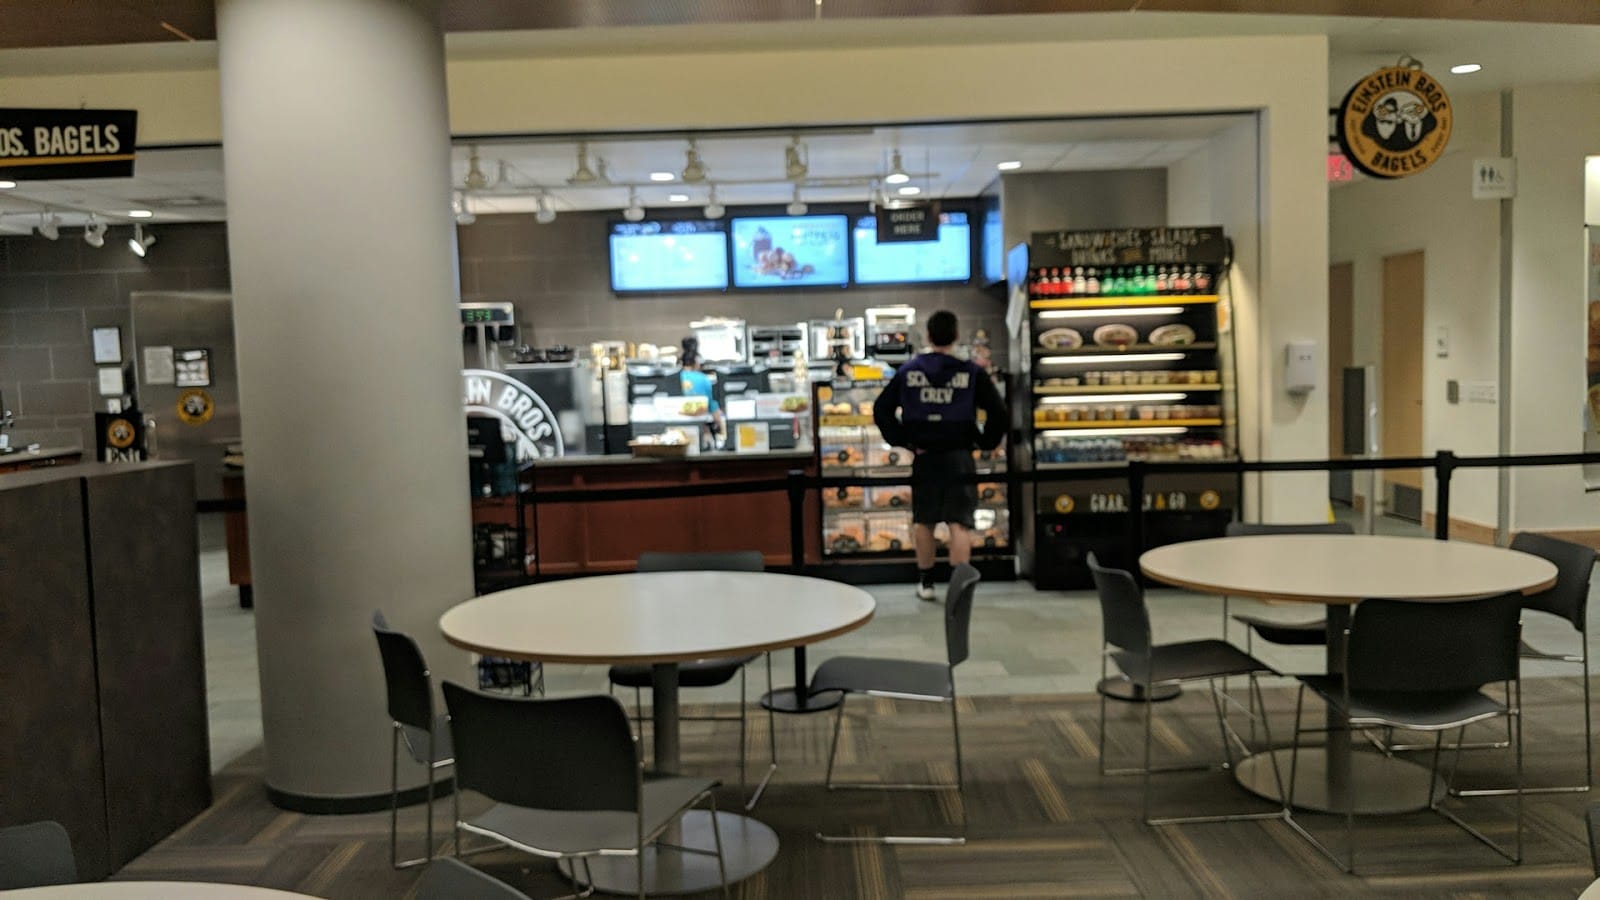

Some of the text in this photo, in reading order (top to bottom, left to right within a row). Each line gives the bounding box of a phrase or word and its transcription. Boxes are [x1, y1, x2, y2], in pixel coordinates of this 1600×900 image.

[1351, 72, 1447, 114] EINSTEIN BROS
[34, 124, 120, 155] BAGELS
[1371, 150, 1427, 171] BAGELS
[920, 387, 954, 404] CREW
[498, 385, 553, 441] BROS
